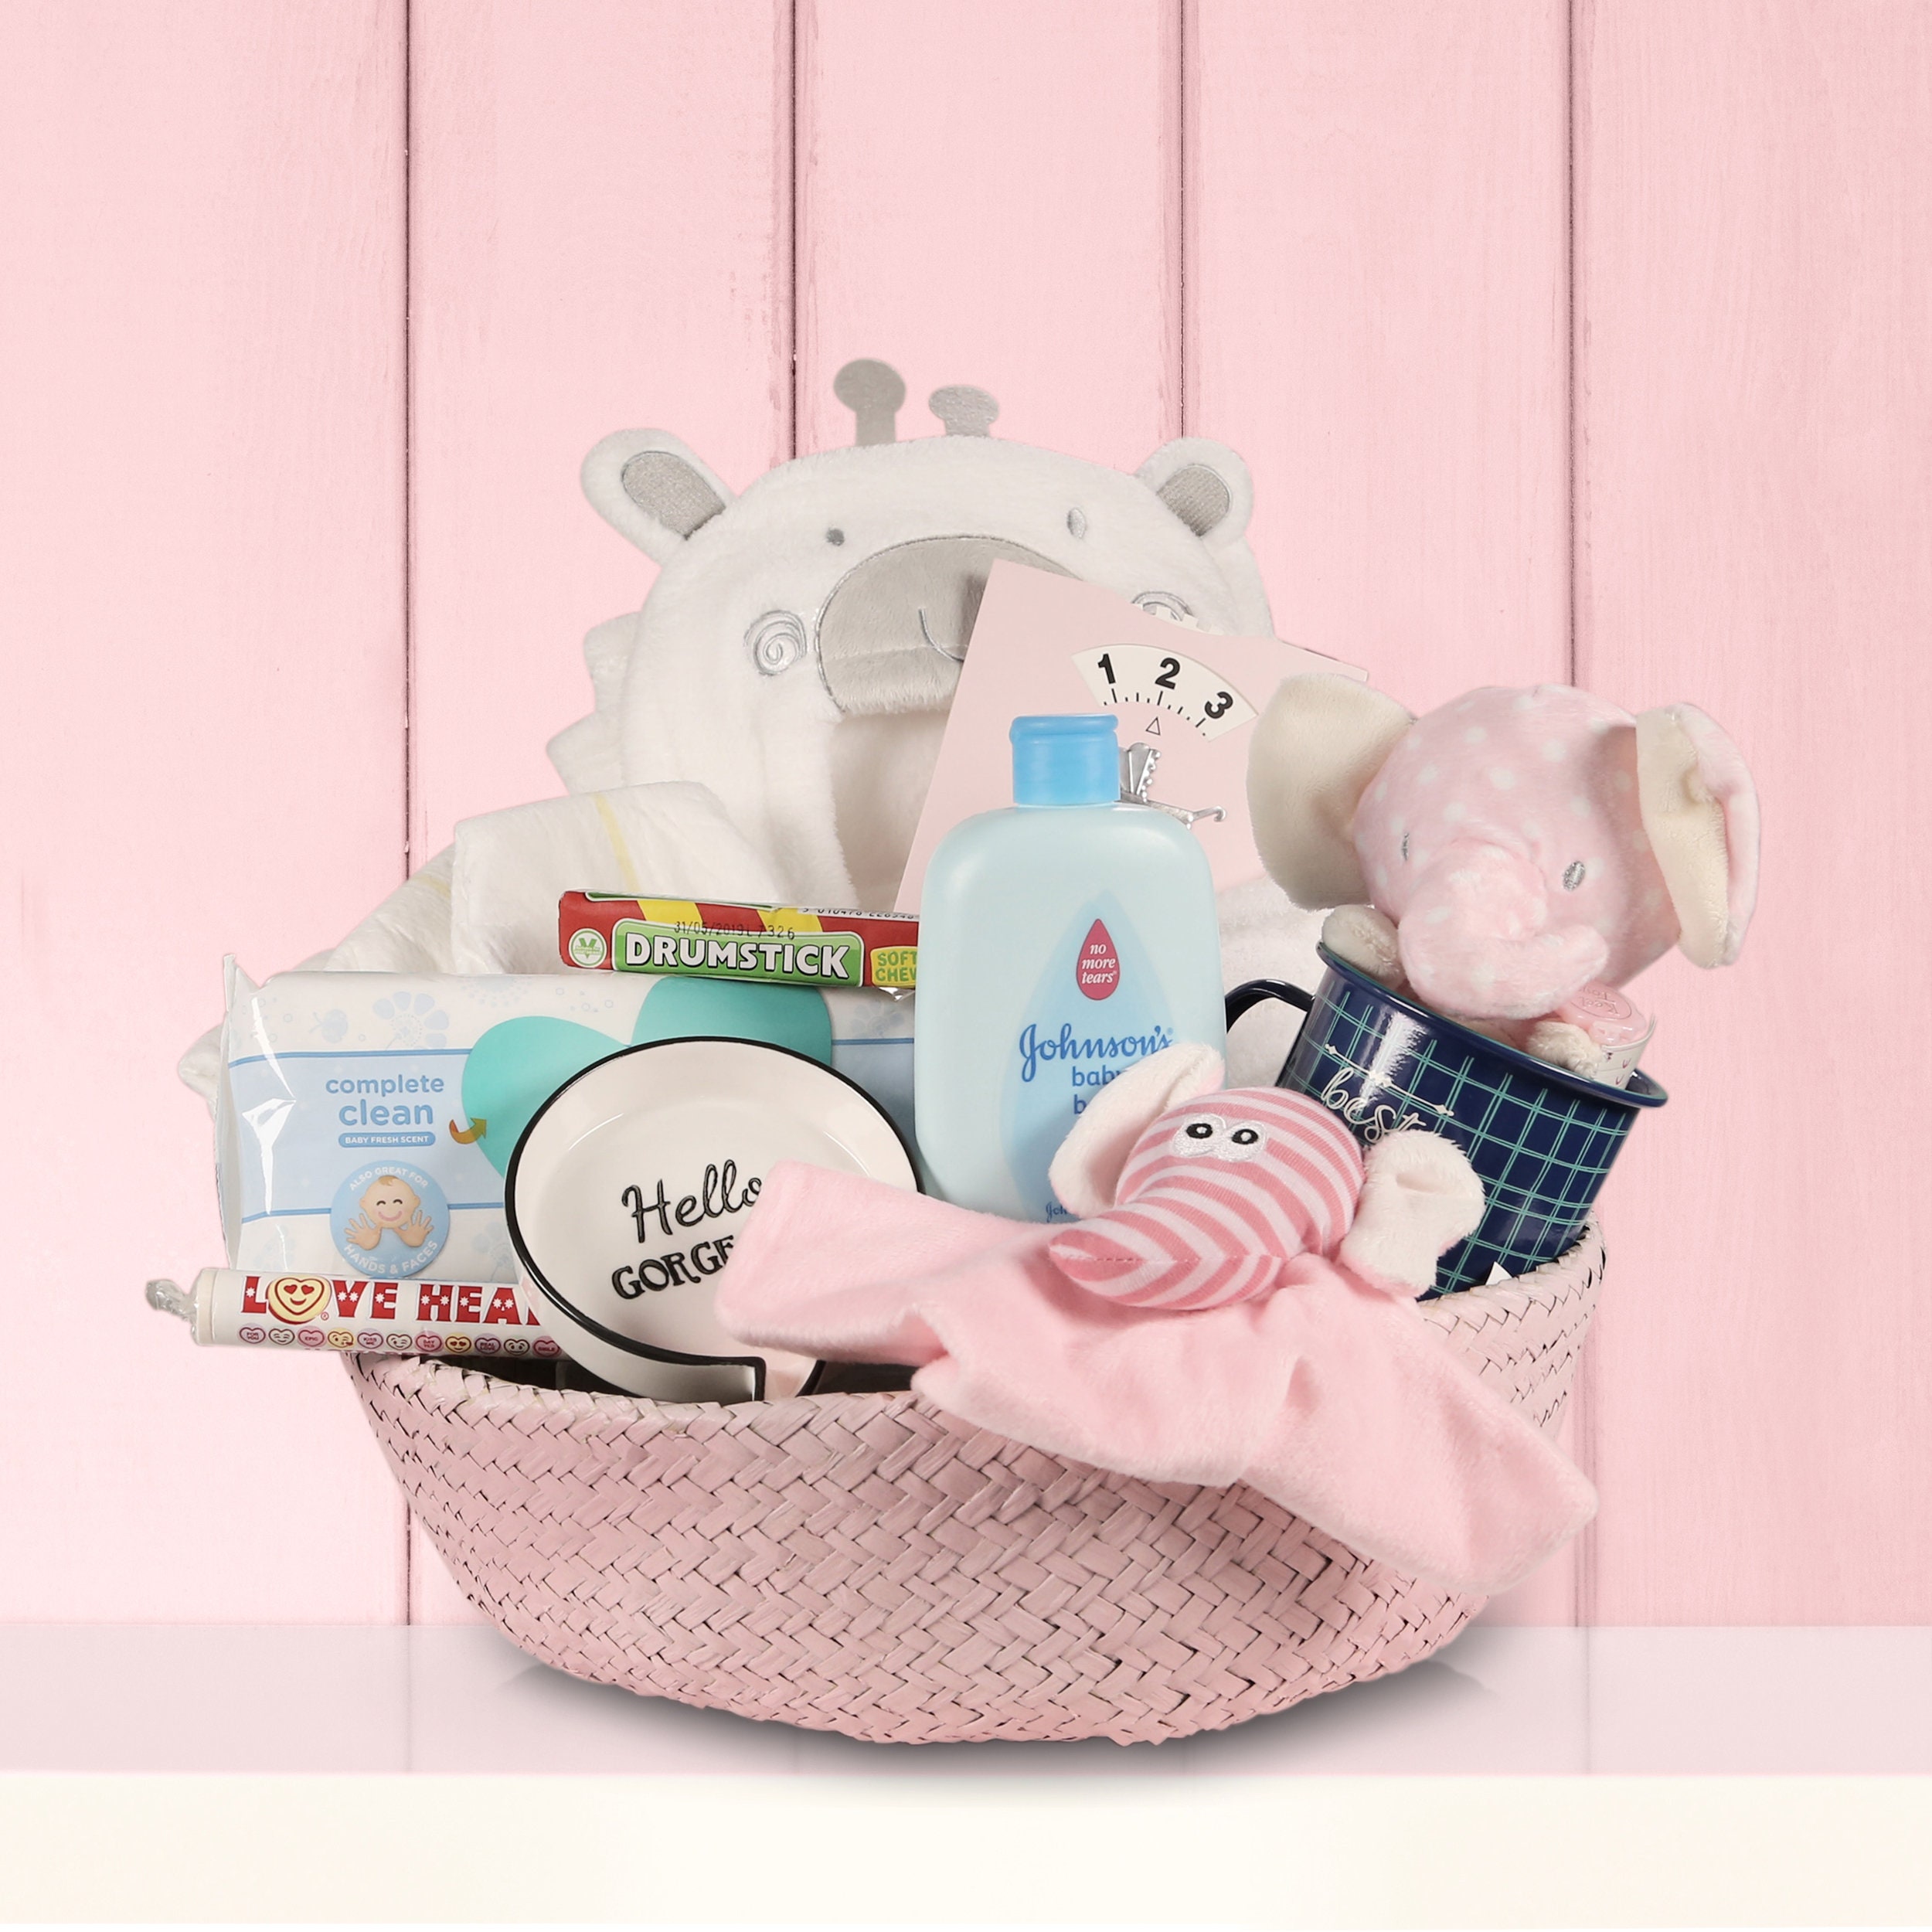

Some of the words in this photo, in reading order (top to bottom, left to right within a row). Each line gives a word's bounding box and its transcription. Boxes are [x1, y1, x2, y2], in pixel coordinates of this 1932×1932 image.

[1097, 653, 1116, 685] 1
[1155, 657, 1181, 690] 2
[1204, 691, 1234, 719] 3
[625, 932, 849, 979] DRUMSTICK
[877, 951, 918, 967] SOFT
[1082, 957, 1116, 970] more
[1090, 944, 1107, 955] no
[1019, 1022, 1173, 1083] Johnson's
[325, 1074, 445, 1097] complete
[338, 1098, 434, 1126] clean
[345, 1136, 369, 1145] BABY
[370, 1135, 399, 1144] FRESH
[400, 1134, 429, 1144] SCENT
[349, 1170, 373, 1192] ALSO
[375, 1165, 409, 1176] GREAT
[409, 1171, 430, 1189] FOR
[621, 1158, 762, 1243] Hello
[343, 1243, 386, 1274] HANDS
[389, 1264, 399, 1274] &
[402, 1240, 438, 1272] FACES
[416, 1283, 541, 1327] HEA
